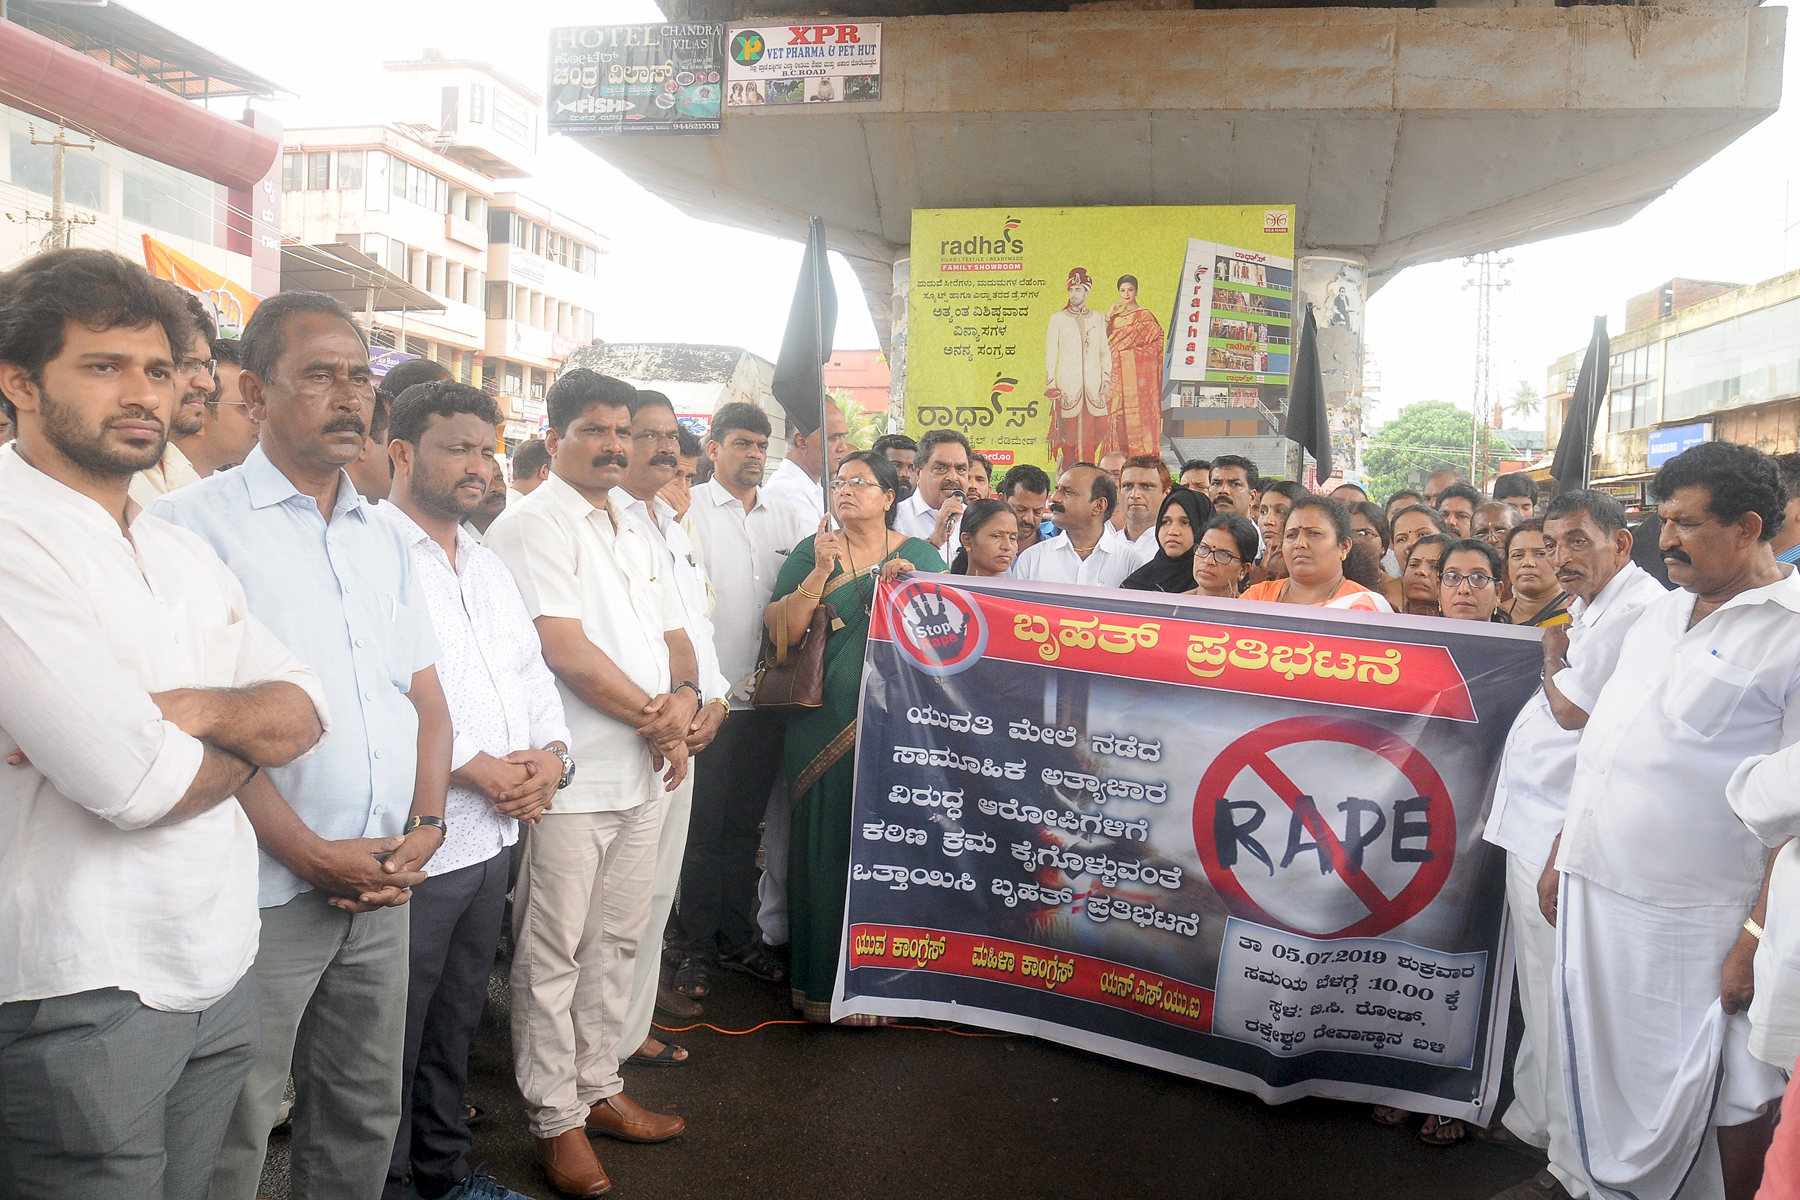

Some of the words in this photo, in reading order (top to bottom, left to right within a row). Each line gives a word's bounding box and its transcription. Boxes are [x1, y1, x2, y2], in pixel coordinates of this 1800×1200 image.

[555, 26, 660, 49] HOTEL
[660, 25, 721, 37] CHANDRA
[672, 39, 709, 49] VILAS
[787, 25, 861, 45] XPR
[766, 48, 784, 60] VET
[785, 46, 825, 59] PHARMA
[828, 45, 836, 57] &
[838, 45, 856, 57] PET
[857, 44, 877, 56] HUT
[553, 65, 598, 89] ಚಂದ್ರ
[608, 59, 674, 84] ವಿಲಾಸ್
[933, 306, 970, 323] ಅತ್ಯಂತ
[973, 305, 1029, 323] ವಿಶಿಷ್ಟವಾದ
[953, 324, 1007, 342] ವಿನ್ಯಾಸಗಳ
[943, 344, 974, 361] ಅನನ್ಯ
[977, 344, 1016, 359] ಸಂಗ್ರಹ
[1651, 442, 1678, 454] SAMSUNG
[915, 622, 951, 638] Stop
[919, 633, 958, 650] Rape
[1013, 614, 1162, 662] ಬೃಹತ್
[1185, 631, 1402, 684] ಪ್ರತಿಭಟನೆ
[906, 703, 994, 735] ಯುವತಿ
[1008, 718, 1077, 748] ಮೇಲೆ
[1092, 733, 1162, 762] ನಡೆದ
[892, 745, 1027, 781] ಸಾಮೂಹಿಕ
[1041, 767, 1168, 805] ಅತ್ಯಾಚಾರ
[888, 783, 965, 821] ವಿರುದ್ಧ
[977, 797, 1149, 842] ಆರೋಪಿಗಳಿಗೆ
[1214, 795, 1436, 878] RAPE
[862, 819, 928, 846] ಕಠಿಣ
[942, 828, 997, 857] ಕ್ರಮ
[1010, 840, 1183, 889] ಕೈಗೊಳ್ಳುವಂತೆ
[852, 861, 977, 891] ಒತ್ತಾಯಿಸಿ
[991, 877, 1076, 908] ಬೃಹತ್
[1087, 893, 1200, 937] ಪ್ರತಿಭಟನೆ
[855, 929, 888, 957] ಯುವ
[892, 932, 947, 968] ಕಾಂಗ್ರೆಸ್
[971, 944, 1016, 972] ಮಹಿಳಾ
[1021, 954, 1075, 990] ಕಾಂಗ್ರೆಸ್
[1238, 935, 1263, 953] ತಾ
[1271, 943, 1388, 966] 05.07.2019
[1397, 955, 1475, 980] ಶುಕ್ರವಾರ
[1244, 966, 1308, 992] ಸಮಯ
[1316, 973, 1360, 995] ಬೆಳಗ್ಗೆ
[1269, 1000, 1303, 1022] ಸ್ಥಳ:
[1310, 1002, 1344, 1016] ಬಿ.ಸಿ.
[1355, 1001, 1426, 1026] ರೋಡ್,
[1244, 1018, 1306, 1050] ರಕ್ತೇಶ್ವರಿ
[1412, 1037, 1446, 1054] ಬಳಿ
